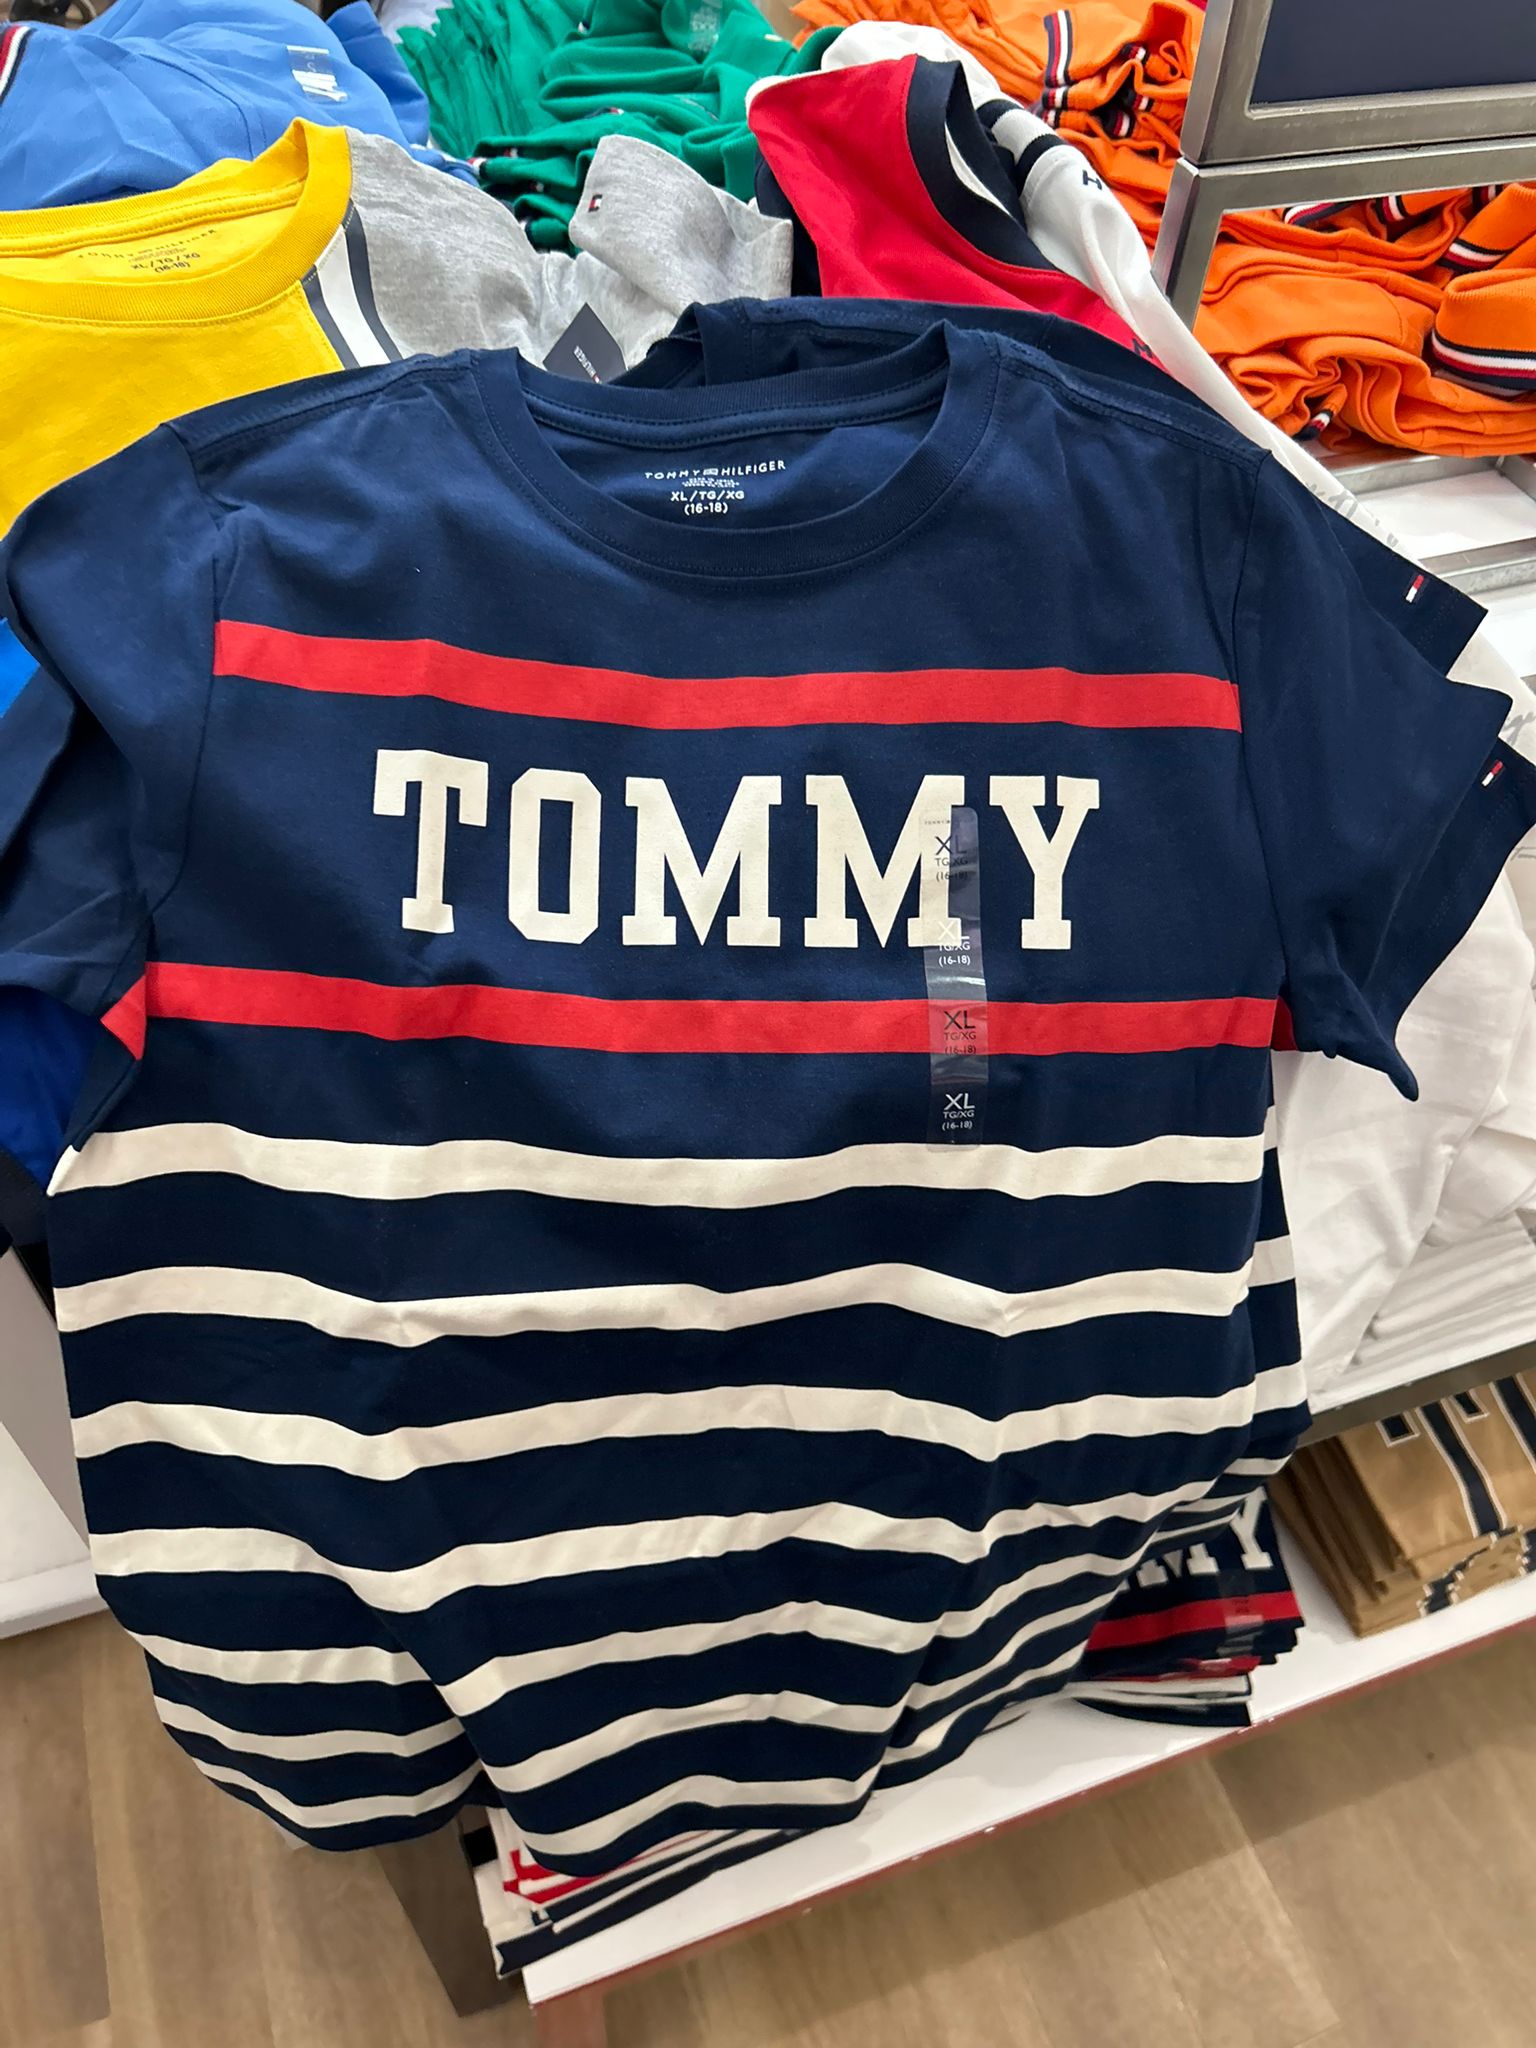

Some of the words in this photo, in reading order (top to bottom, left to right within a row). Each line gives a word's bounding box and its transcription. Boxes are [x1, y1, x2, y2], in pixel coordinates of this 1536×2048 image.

[645, 469, 701, 480] TOMMY
[721, 460, 786, 476] HILFIGER
[684, 502, 729, 516] (16-18)
[372, 748, 1100, 951] TOMMY
[934, 835, 968, 856] XL
[938, 955, 971, 968] (16-18)
[944, 1010, 976, 1030] XL
[943, 1031, 977, 1041] TG/XG
[944, 1045, 977, 1055] (16-18)
[943, 1093, 976, 1111] XL
[942, 1110, 975, 1119] TG/XG
[941, 1120, 973, 1131] (16-18)
